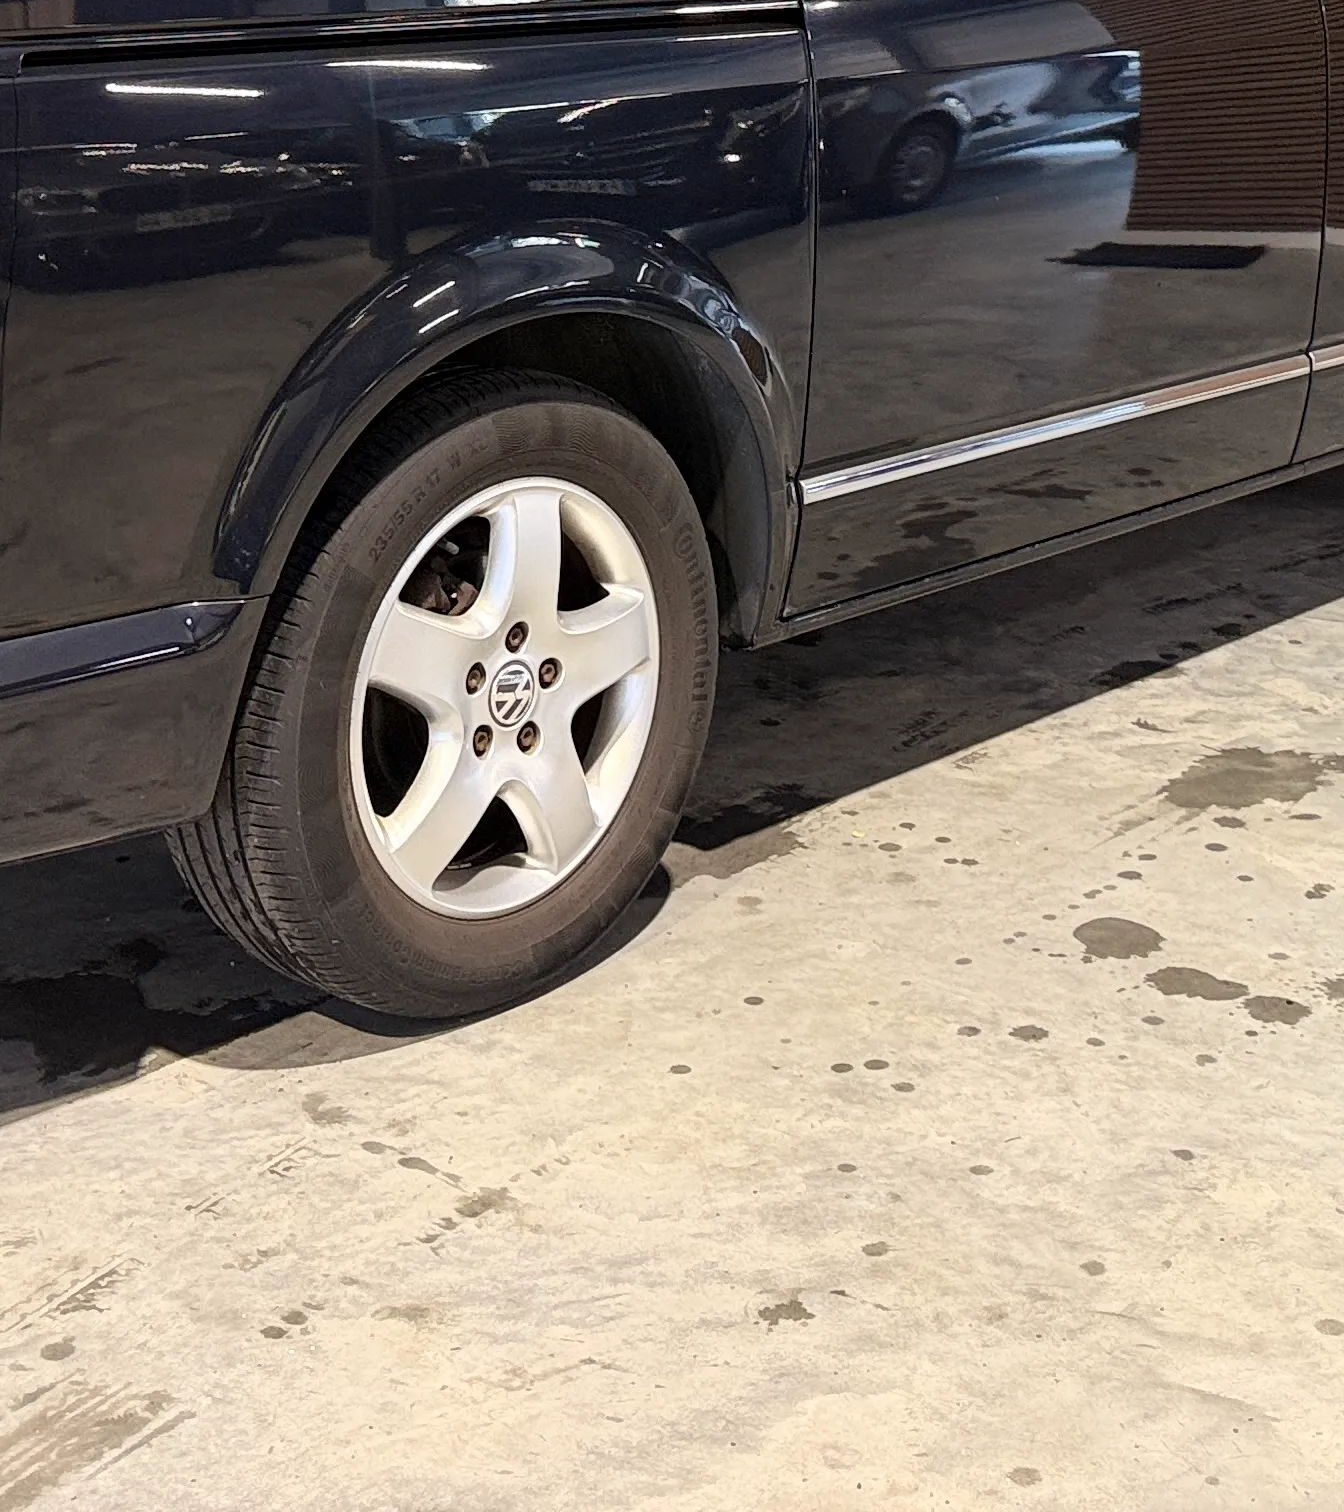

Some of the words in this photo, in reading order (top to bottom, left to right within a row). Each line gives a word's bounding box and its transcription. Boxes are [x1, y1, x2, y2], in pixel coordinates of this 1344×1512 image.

[368, 499, 413, 562] 235/55
[414, 488, 428, 504] R
[672, 520, 713, 704] Continental
